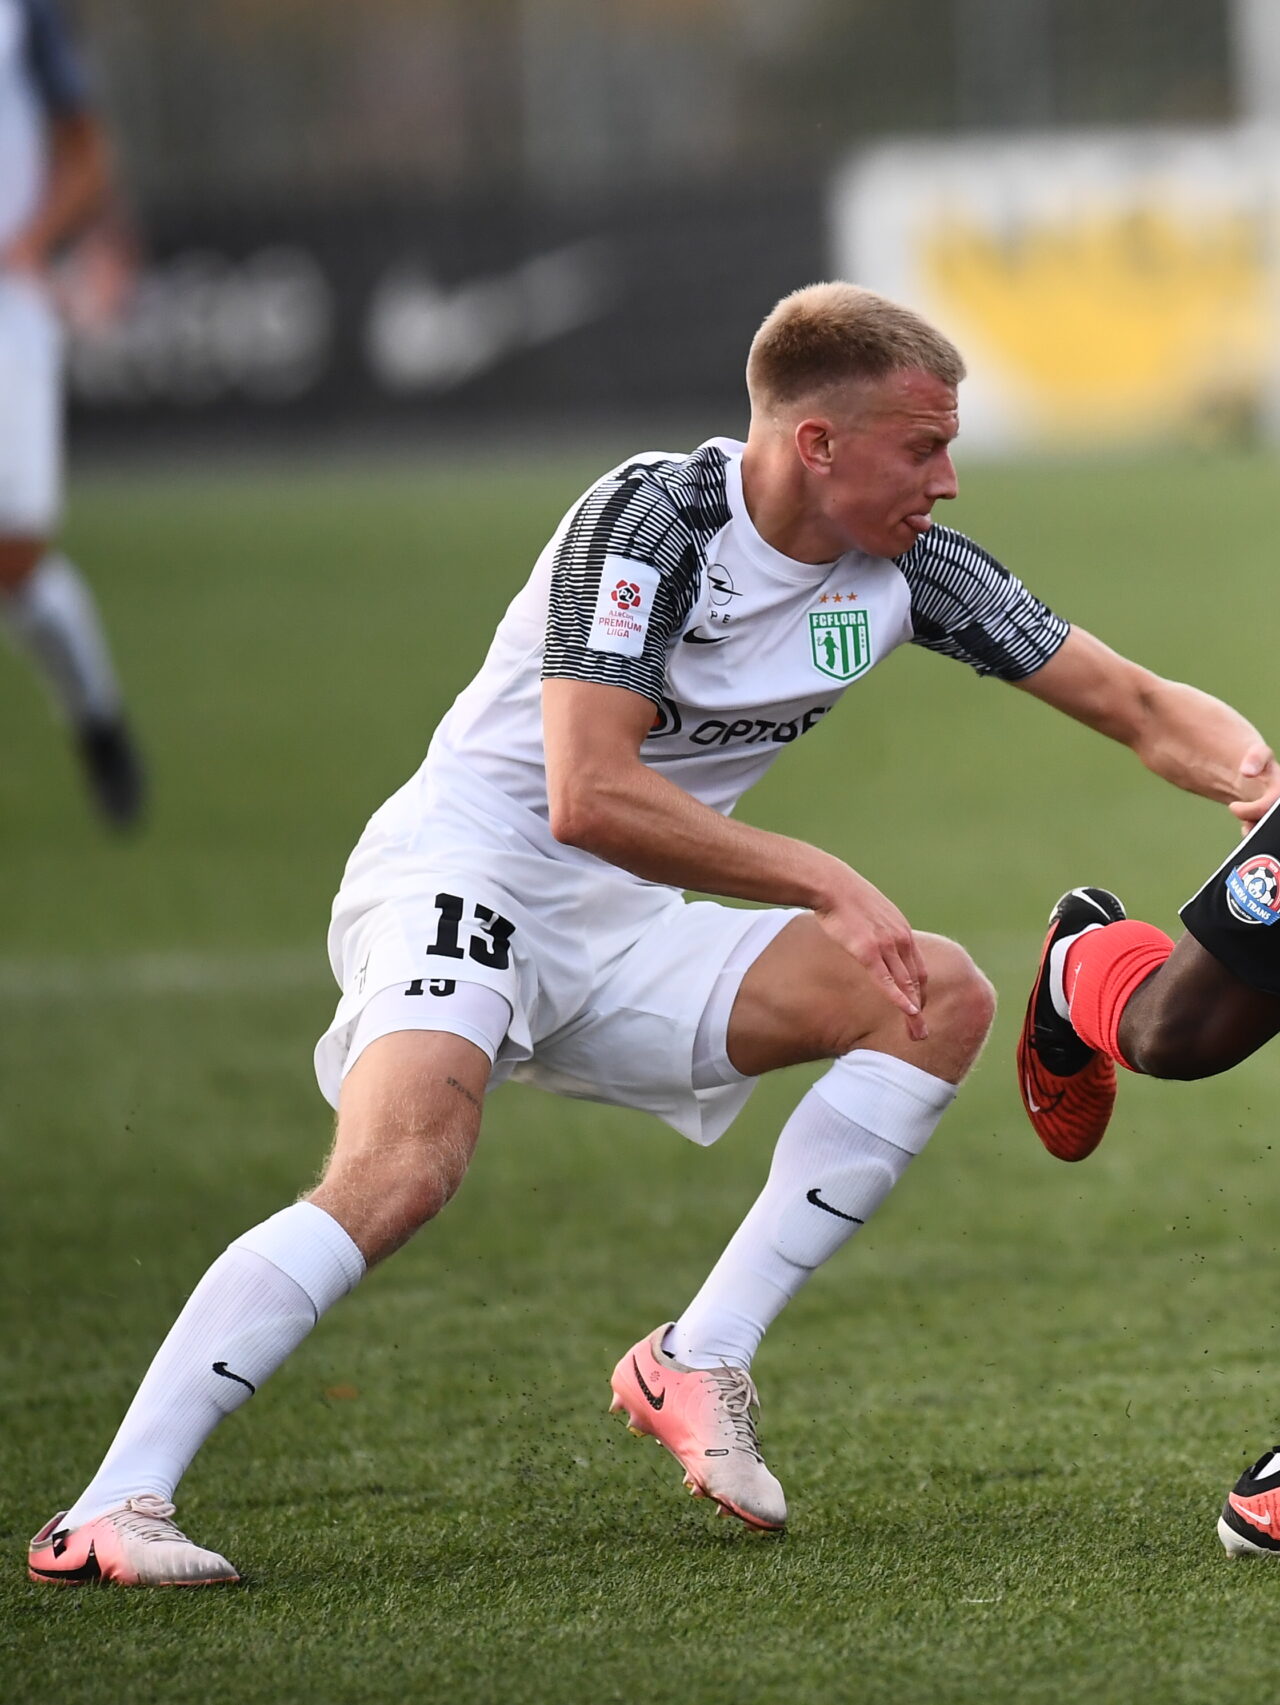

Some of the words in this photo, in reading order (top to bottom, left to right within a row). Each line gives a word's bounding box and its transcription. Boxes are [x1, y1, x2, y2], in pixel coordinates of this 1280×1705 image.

[598, 617, 642, 633] PREMIUM
[607, 628, 630, 639] LIIGA
[1247, 899, 1271, 920] TRANS
[426, 893, 516, 970] 13
